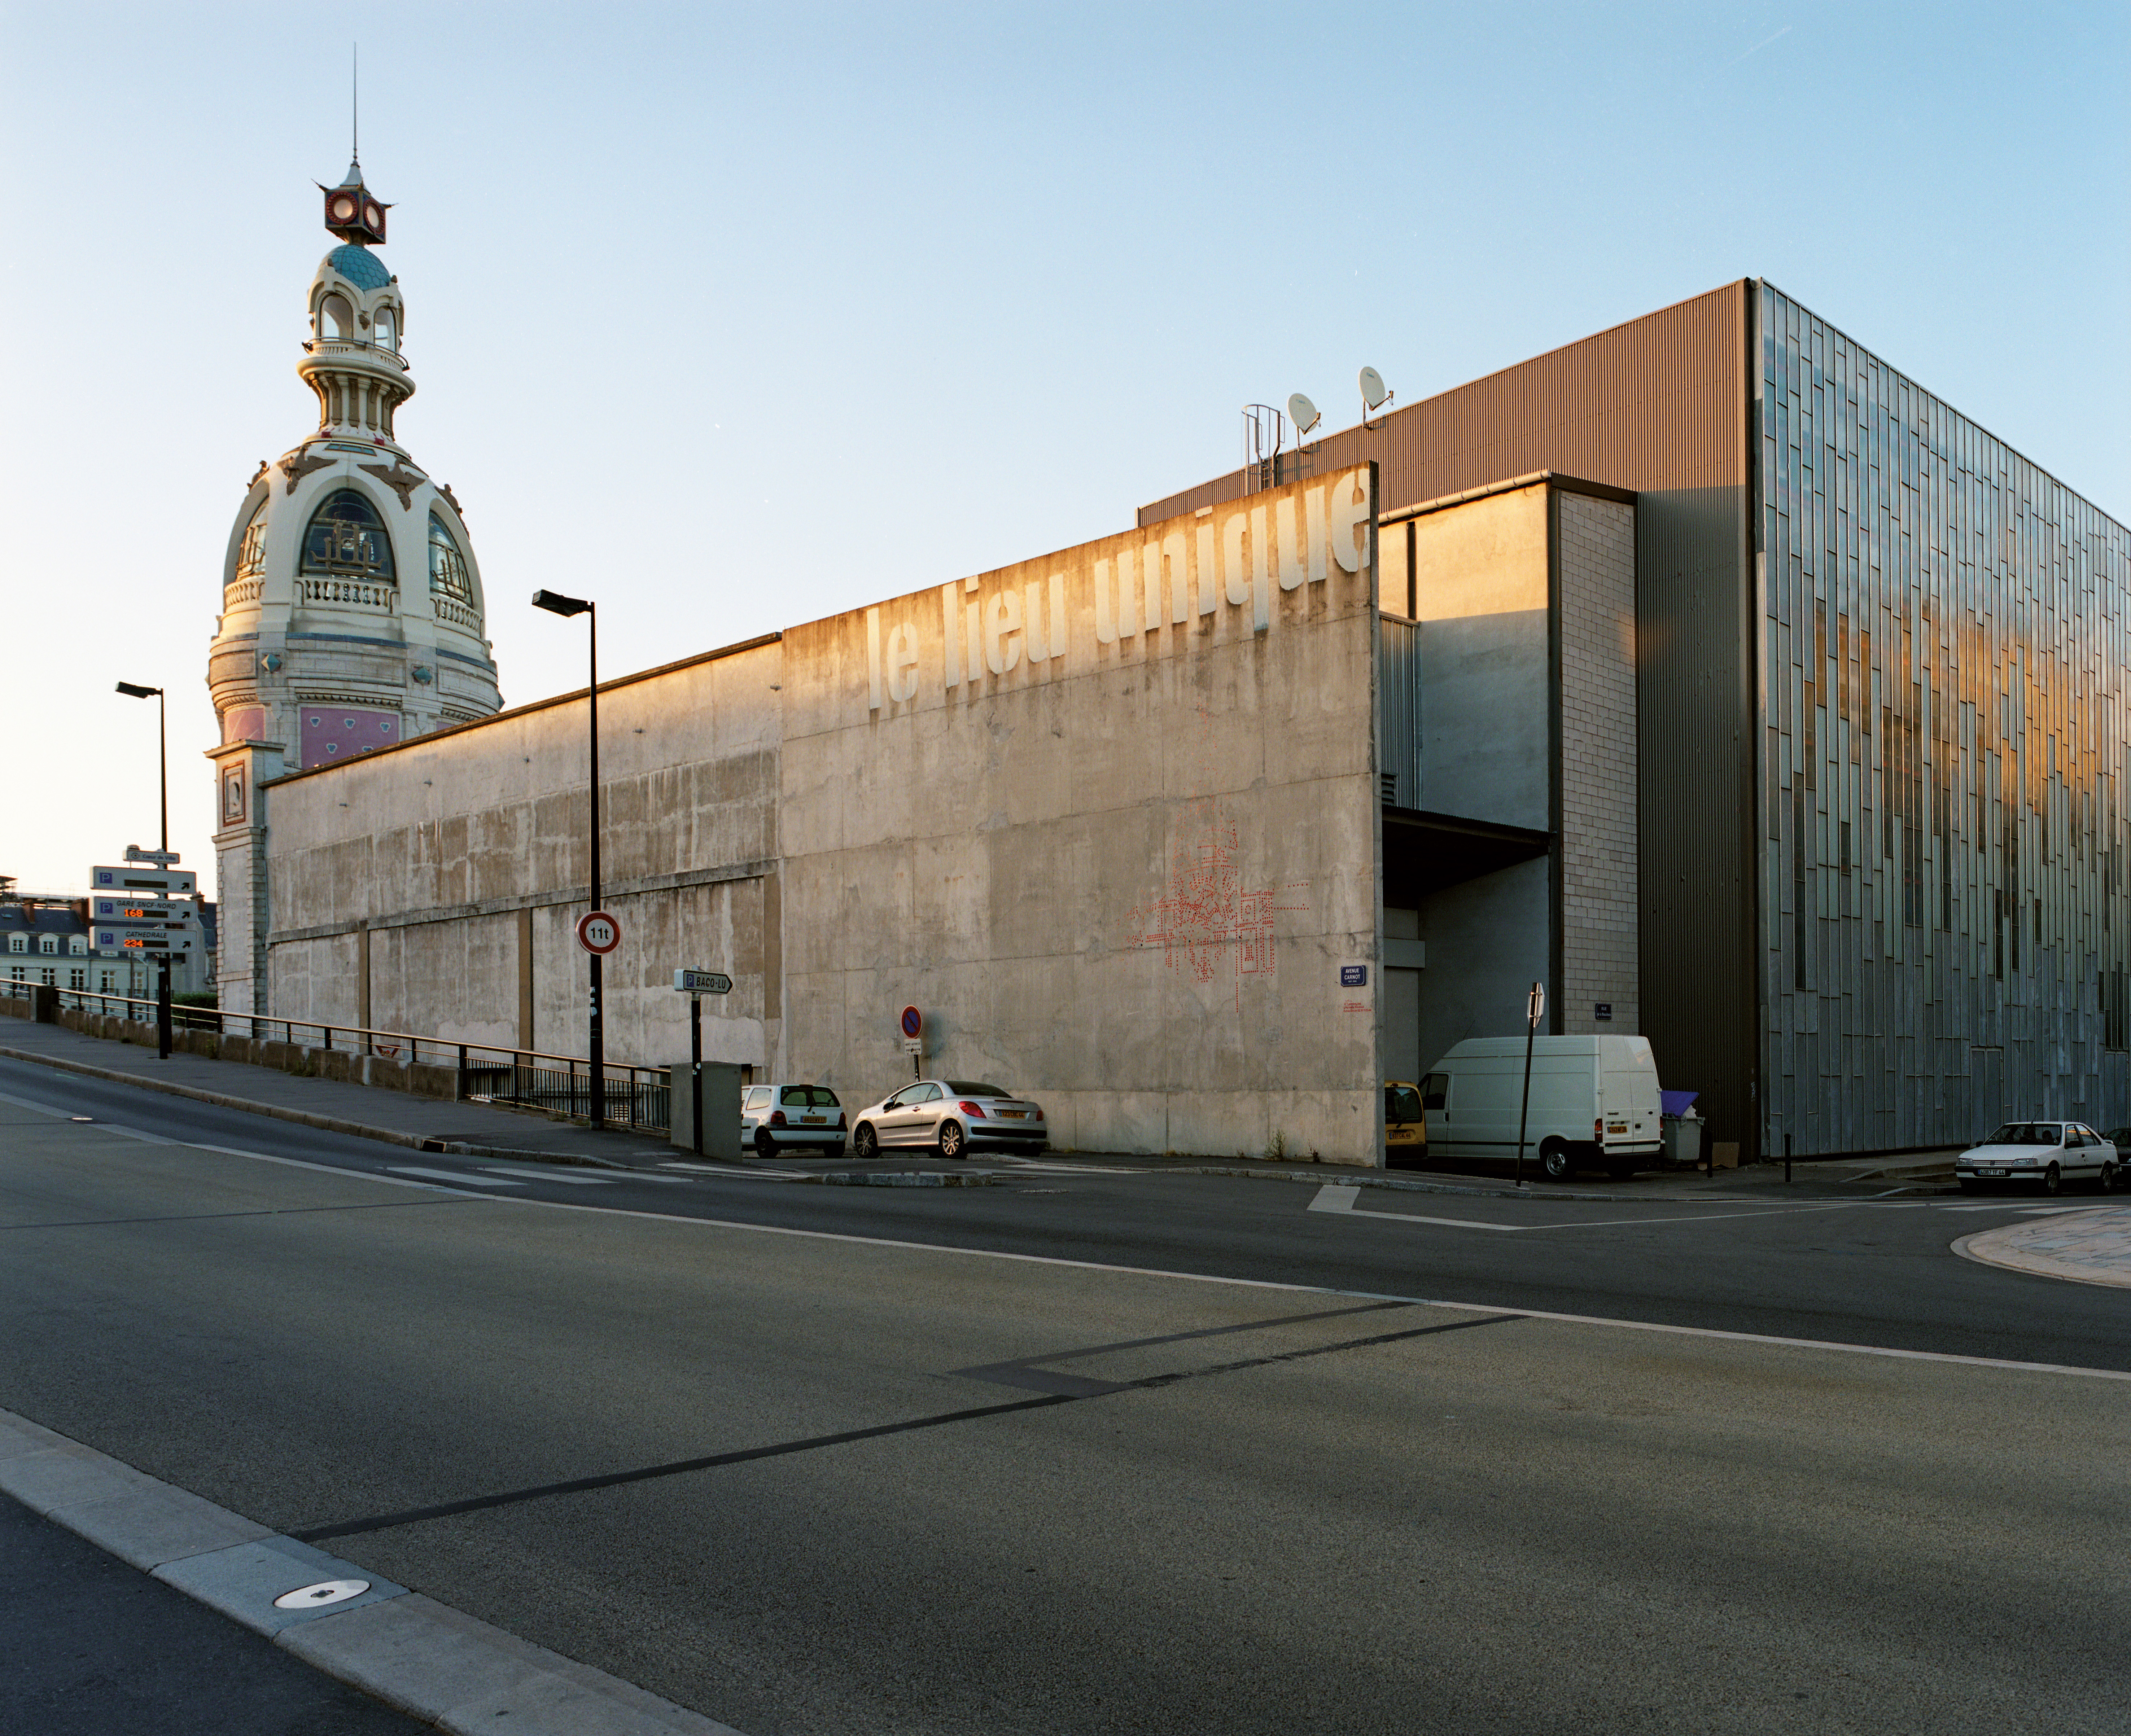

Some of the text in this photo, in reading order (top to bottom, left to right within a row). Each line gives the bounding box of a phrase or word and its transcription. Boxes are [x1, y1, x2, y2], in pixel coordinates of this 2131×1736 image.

[867, 468, 1370, 710] le lieu unique
[124, 909, 143, 917] 168
[591, 927, 609, 939] 11t
[124, 939, 143, 947] 234
